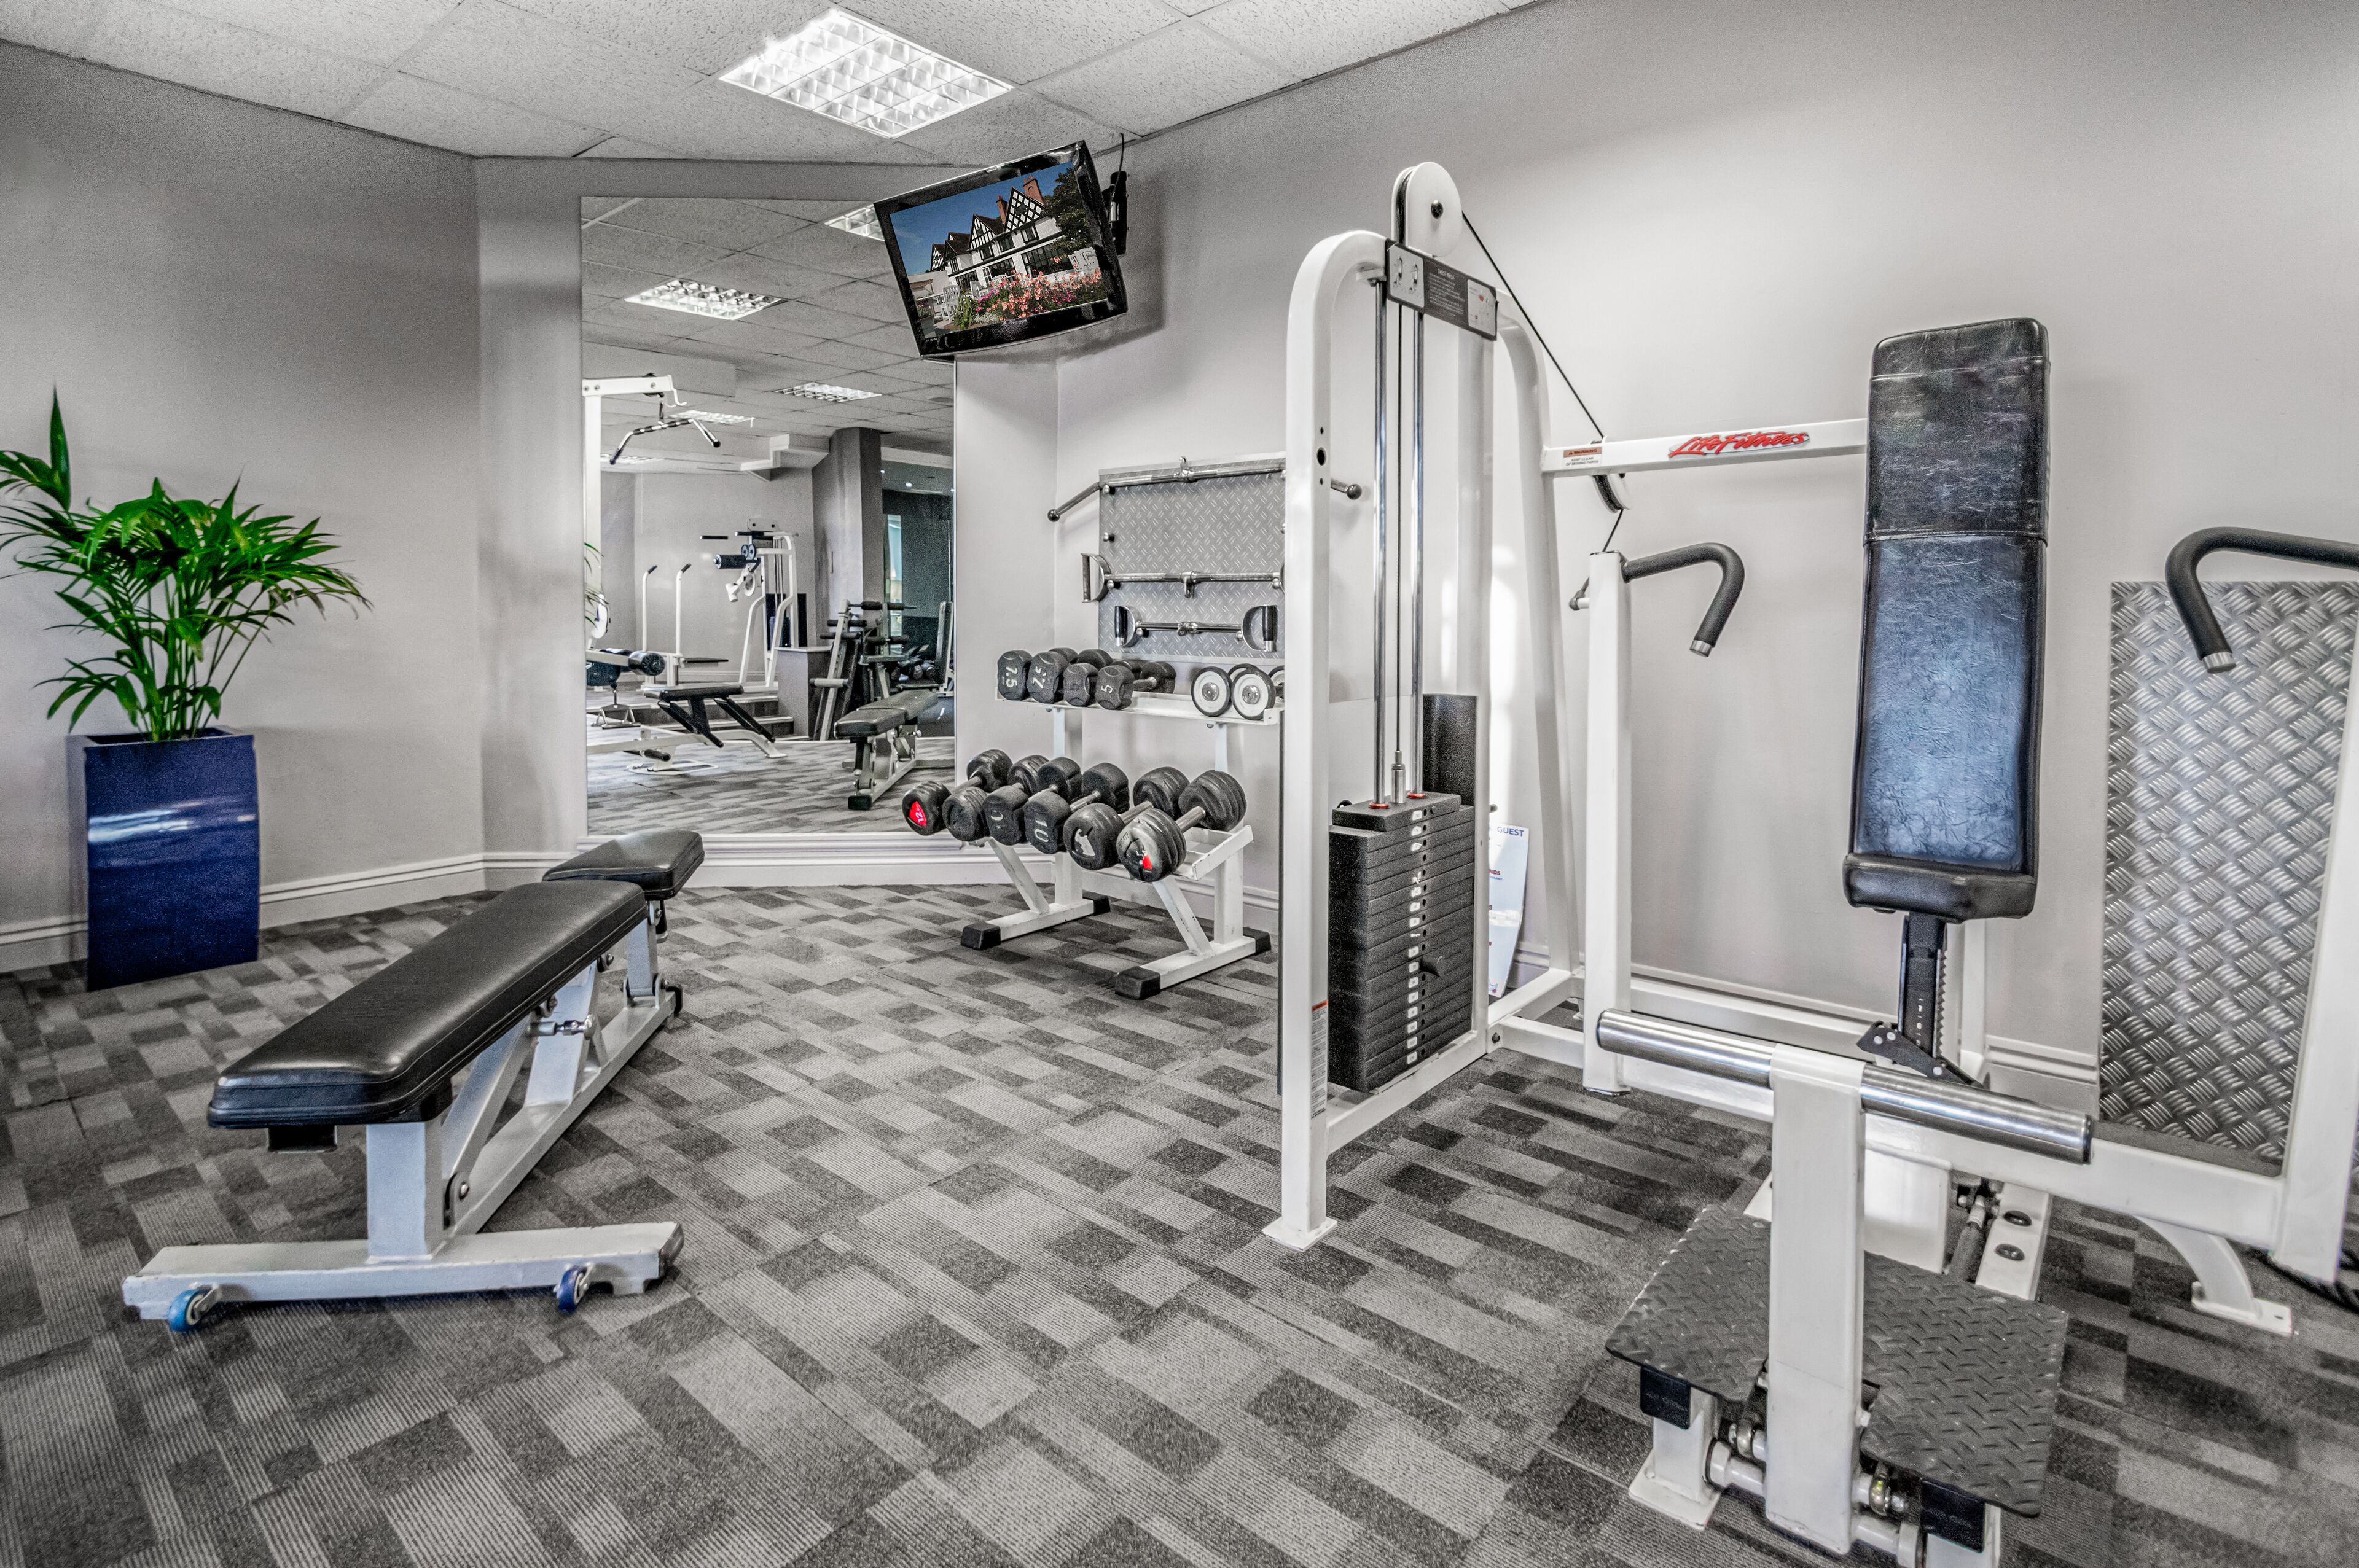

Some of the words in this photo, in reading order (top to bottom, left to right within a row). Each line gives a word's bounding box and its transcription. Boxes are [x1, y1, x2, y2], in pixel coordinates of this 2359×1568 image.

[1006, 666, 1018, 688] 7.5
[1101, 684, 1113, 693] 5
[915, 810, 925, 824] 12
[1035, 819, 1049, 843] 10
[1496, 826, 1524, 837] GUEST
